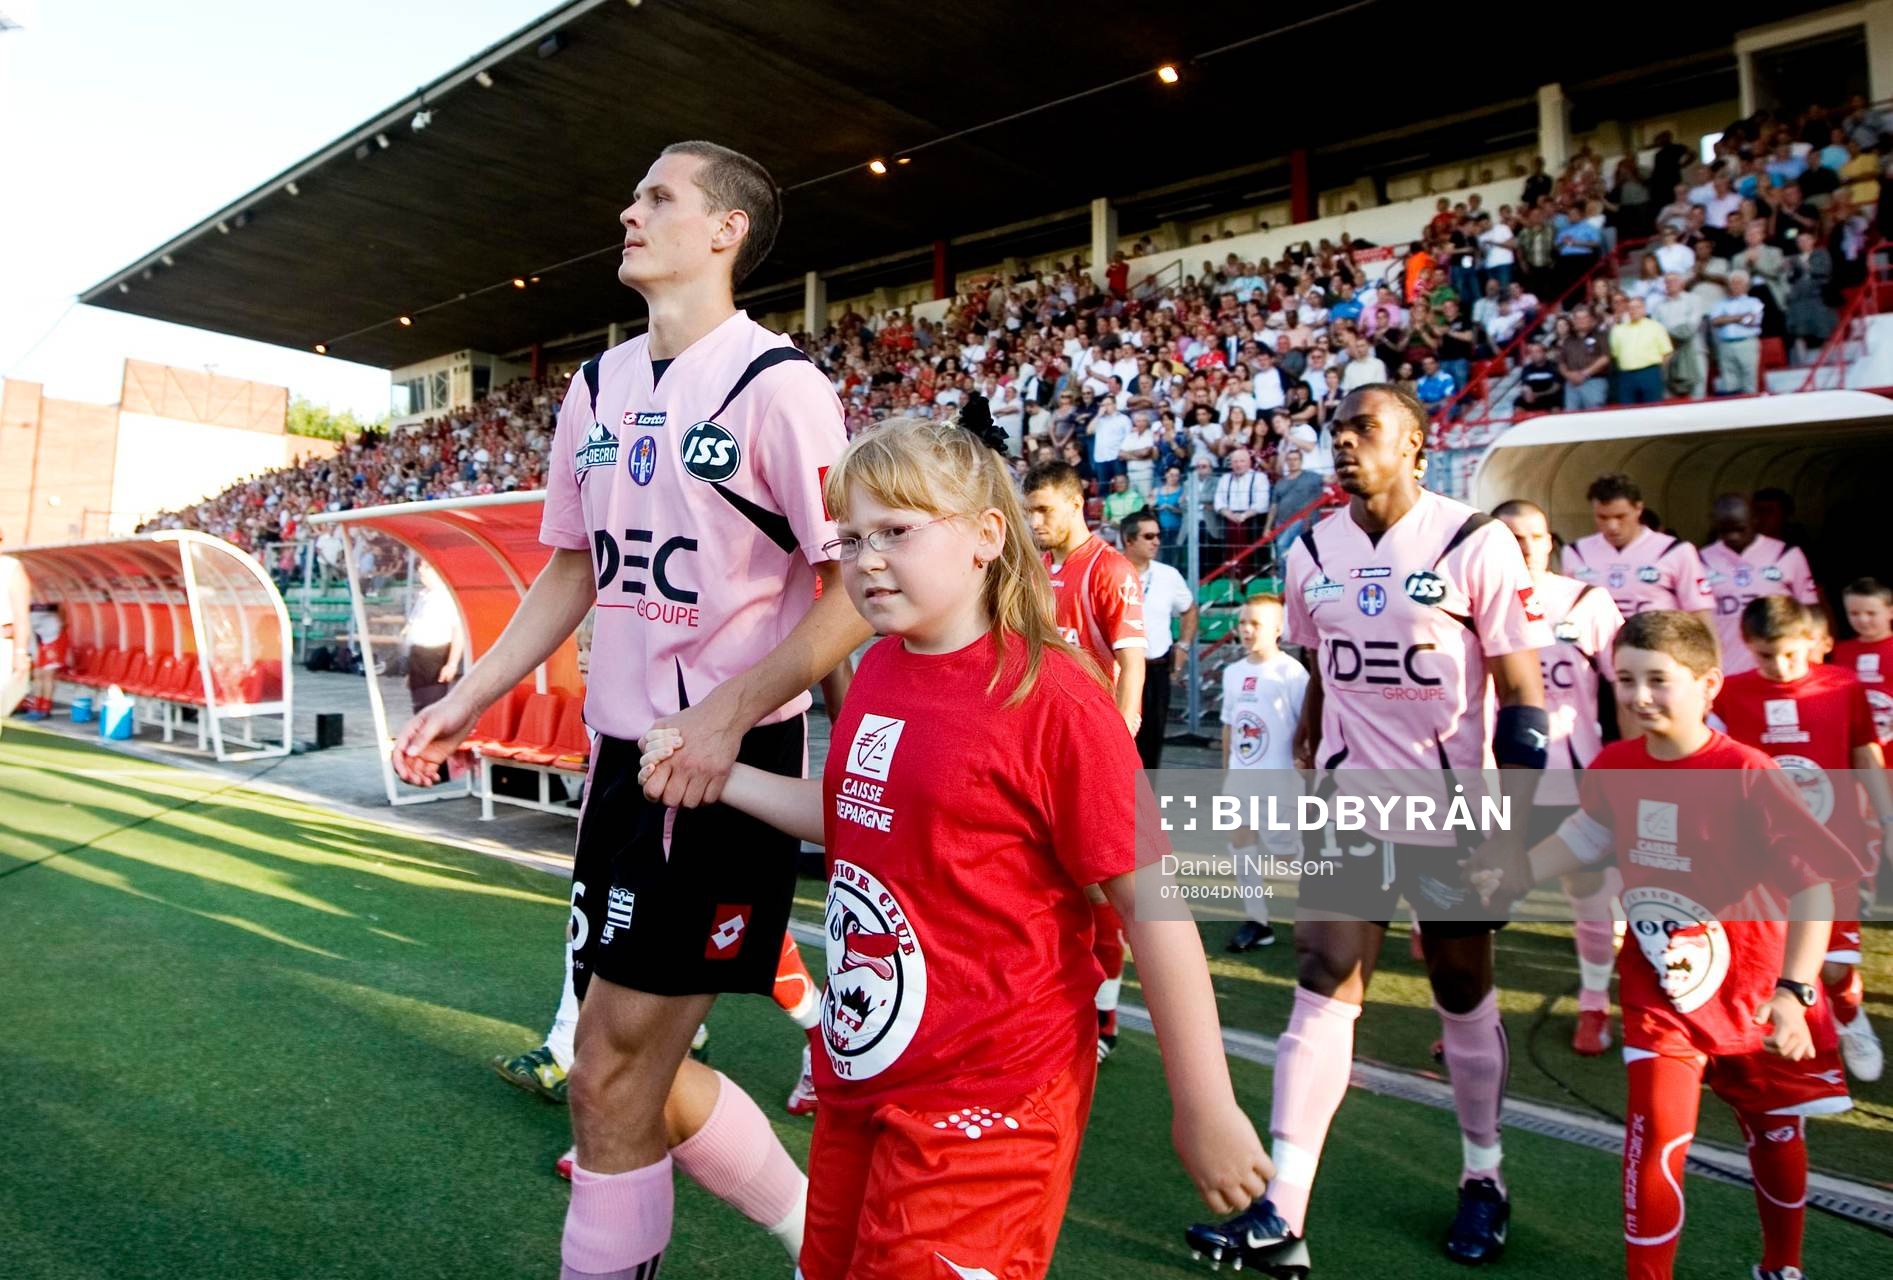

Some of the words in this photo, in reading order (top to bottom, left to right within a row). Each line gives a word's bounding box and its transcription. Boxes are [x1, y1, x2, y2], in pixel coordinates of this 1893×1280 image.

[637, 414, 666, 424] Lotto
[1382, 687, 1446, 701] GROUPE
[842, 778, 884, 803] CAISSE
[878, 892, 916, 956] CLUB
